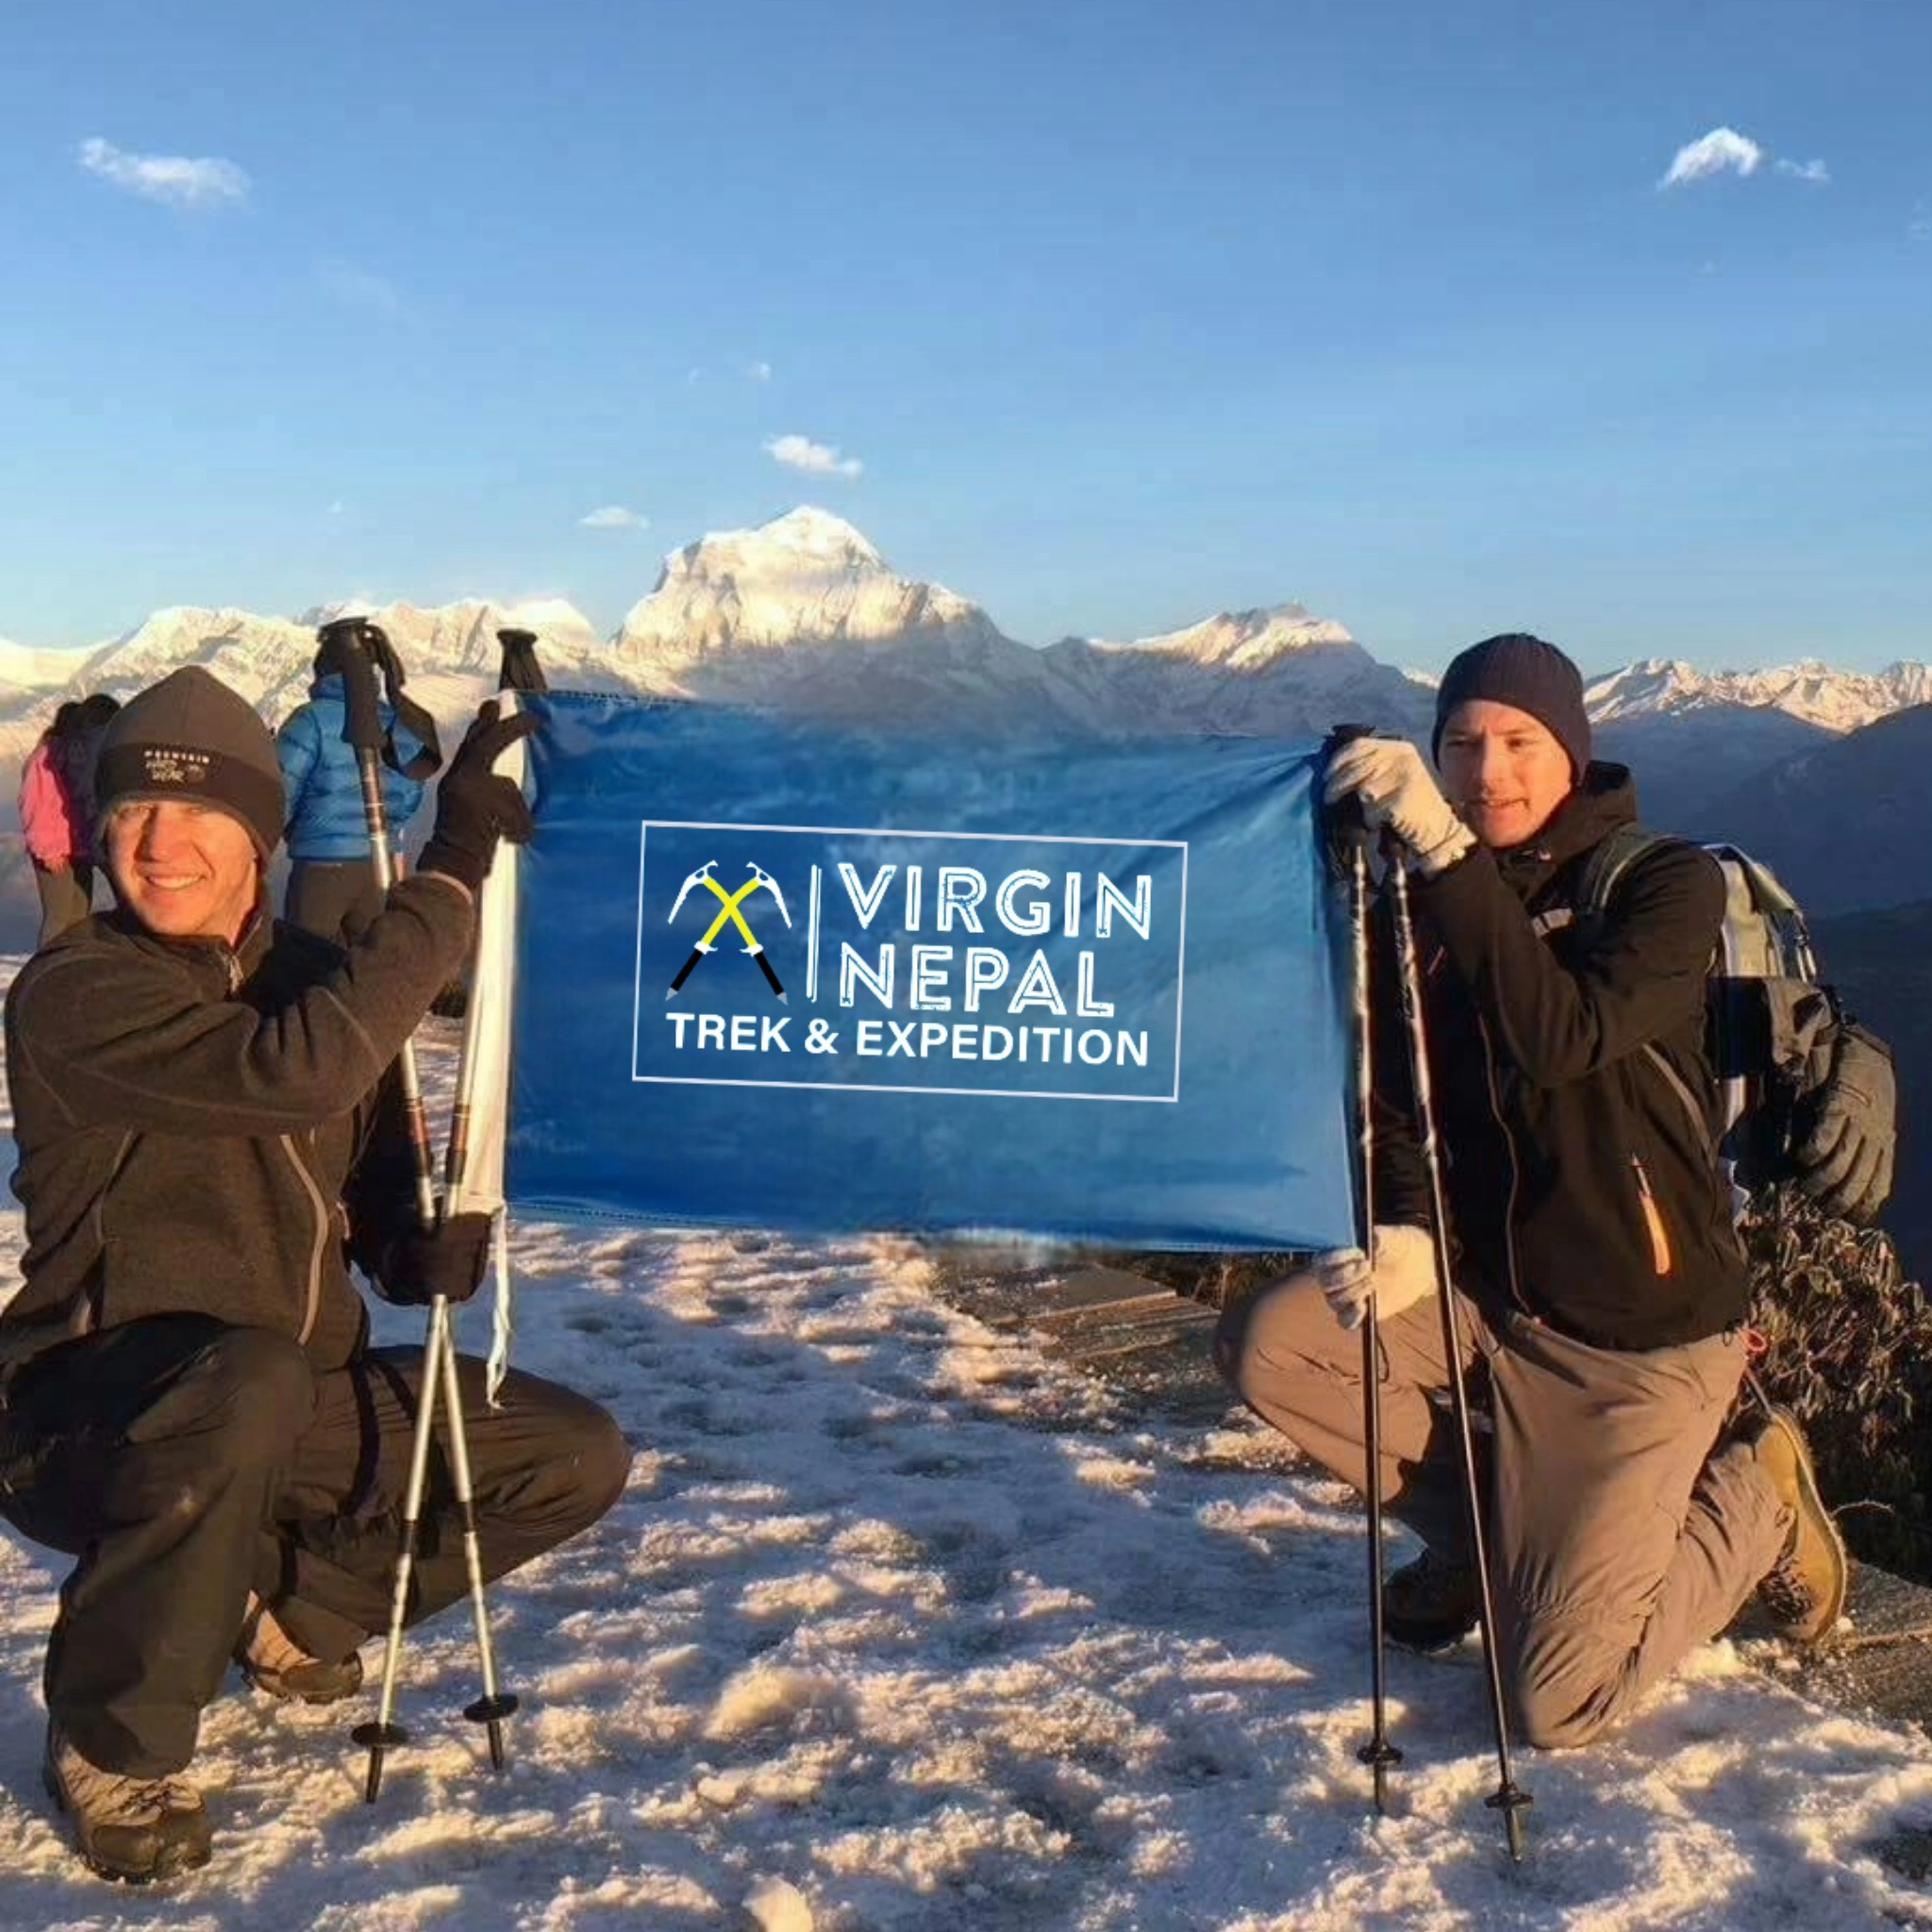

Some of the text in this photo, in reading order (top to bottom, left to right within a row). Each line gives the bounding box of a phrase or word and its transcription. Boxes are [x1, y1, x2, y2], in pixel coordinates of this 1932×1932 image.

[838, 862, 1153, 940] VIRGIN
[839, 941, 1115, 1018] NEPAL
[665, 1011, 1149, 1067] TREK & EXPEDITION
